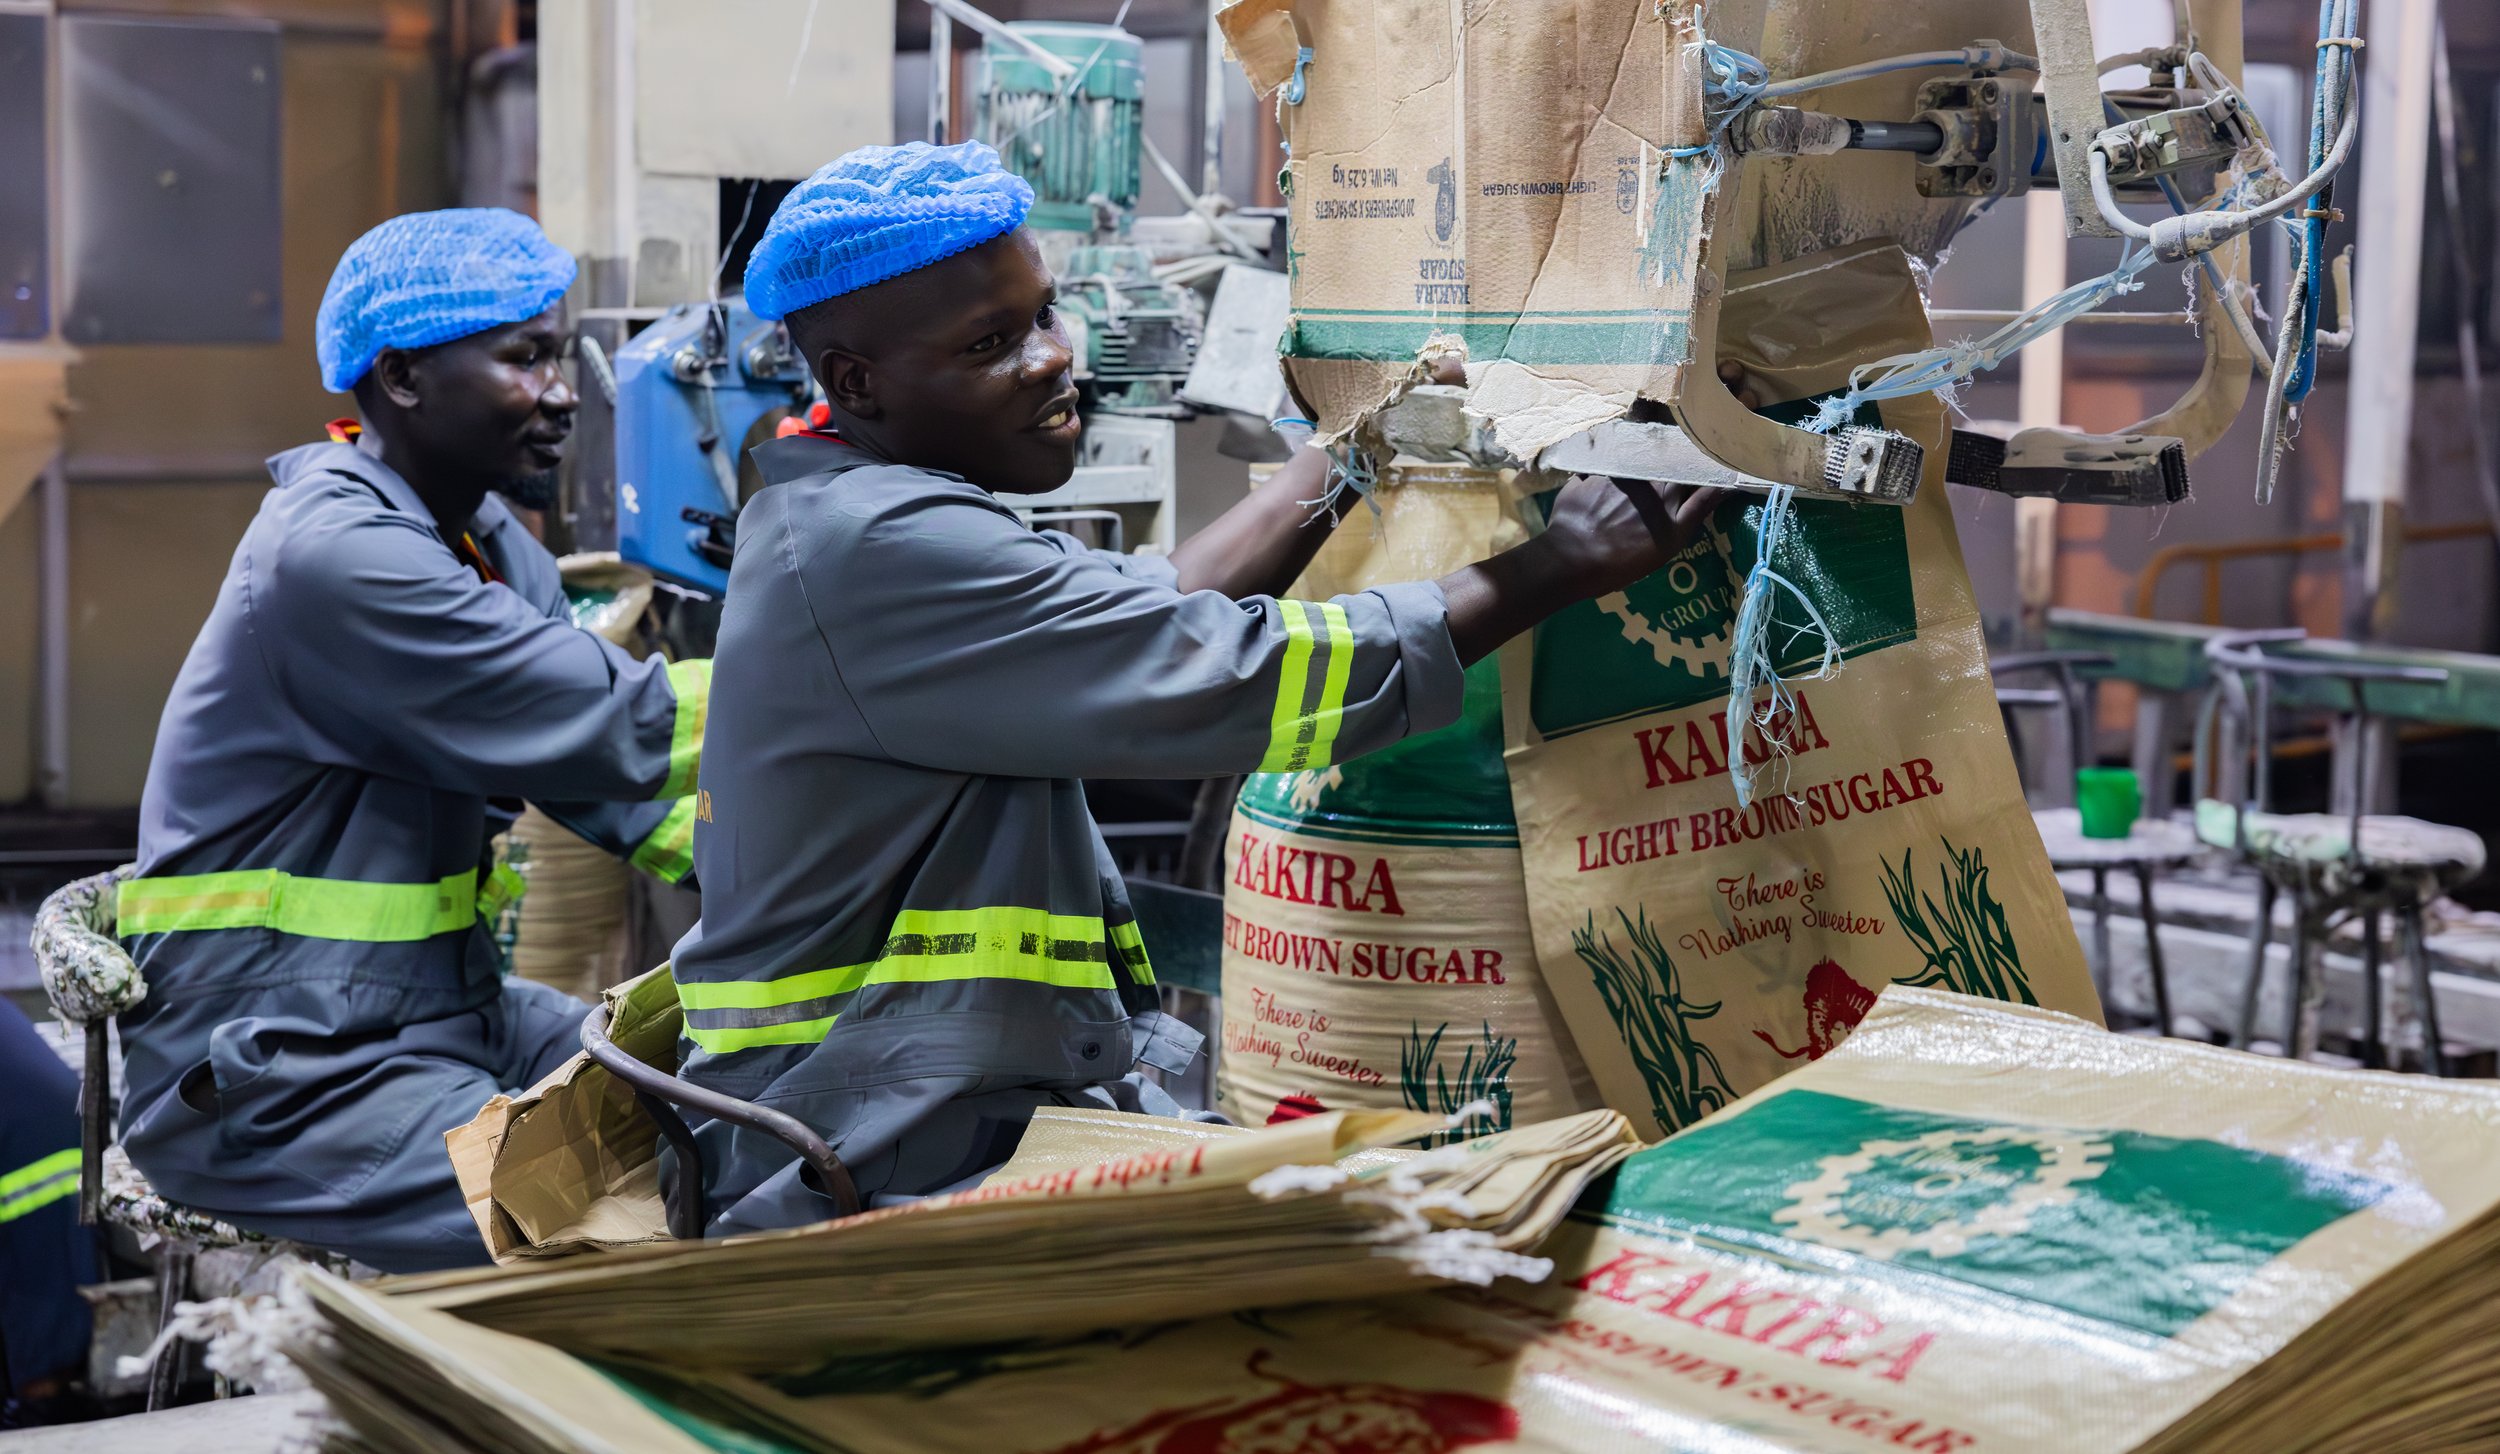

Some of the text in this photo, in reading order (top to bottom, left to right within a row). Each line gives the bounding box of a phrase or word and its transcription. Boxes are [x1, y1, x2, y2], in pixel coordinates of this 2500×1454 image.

[1332, 164, 1345, 188] kg
[1347, 170, 1367, 188] 6.25
[1383, 168, 1398, 188] Net
[1482, 183, 1519, 197] SUGAR
[1521, 181, 1564, 196] BROWN
[1315, 200, 1348, 219] SACHETS
[1365, 198, 1405, 219] DISPENSERS
[1406, 198, 1415, 217] 20
[1419, 259, 1466, 280] SUGAR
[1414, 284, 1470, 305] KAKIRA
[1660, 586, 1729, 630] GROUP
[1576, 757, 1944, 873] LIGHT BROWN SUGAR
[1233, 833, 1405, 916] KAKIRA
[1716, 867, 1826, 912] There is
[1678, 894, 1886, 960] Nothing Sweeter
[1243, 921, 1343, 976] BROWN
[1351, 942, 1506, 985] SUGAR
[1251, 986, 1333, 1033] There is
[1290, 1031, 1387, 1088] Sweeter
[1562, 1247, 1938, 1384] KAKIRA
[1746, 1374, 1978, 1454] SUGAR
